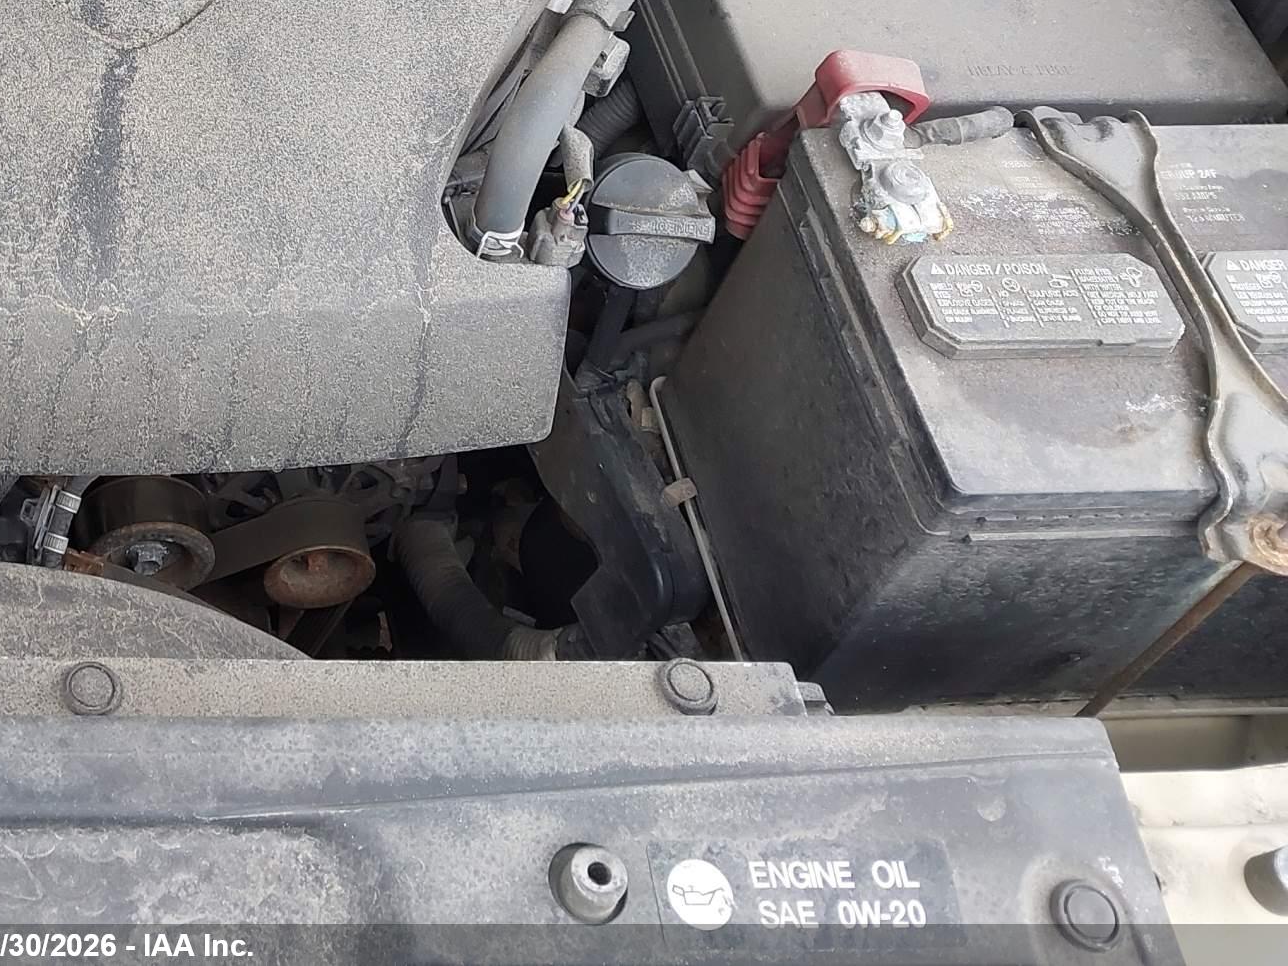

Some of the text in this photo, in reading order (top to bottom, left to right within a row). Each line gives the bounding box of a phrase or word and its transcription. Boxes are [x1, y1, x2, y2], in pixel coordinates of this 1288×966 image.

[944, 263, 993, 275] DANGER
[1003, 263, 1049, 275] POISON
[1238, 259, 1288, 271] DANGER
[748, 860, 921, 889] ENGINE OIL
[759, 899, 927, 929] SAE 0W-20
